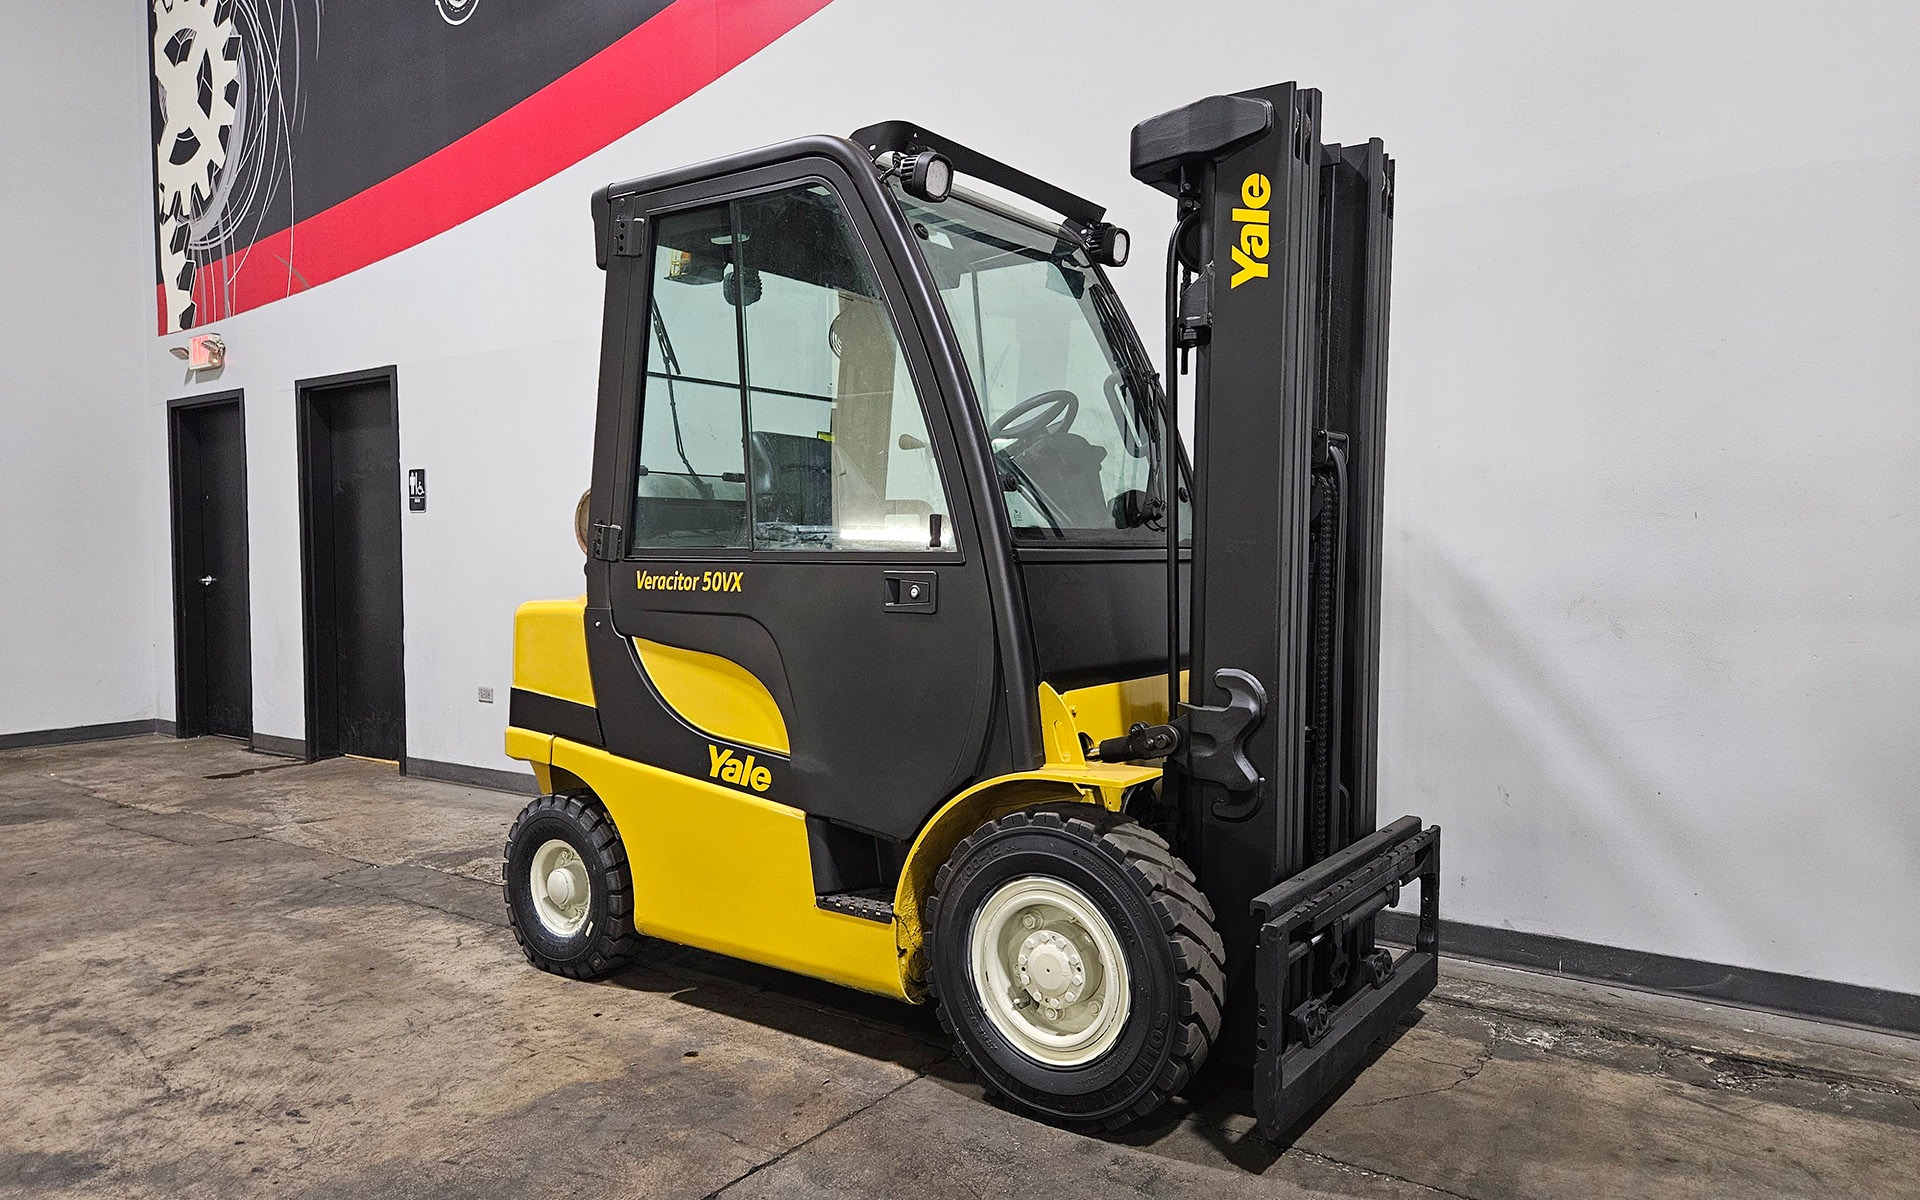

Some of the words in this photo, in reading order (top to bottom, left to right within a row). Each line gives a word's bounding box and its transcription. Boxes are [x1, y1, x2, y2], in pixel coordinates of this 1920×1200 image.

[1231, 172, 1272, 289] Yale
[636, 571, 698, 592] Veracitor
[702, 572, 744, 593] 50VX
[708, 745, 772, 792] Yale
